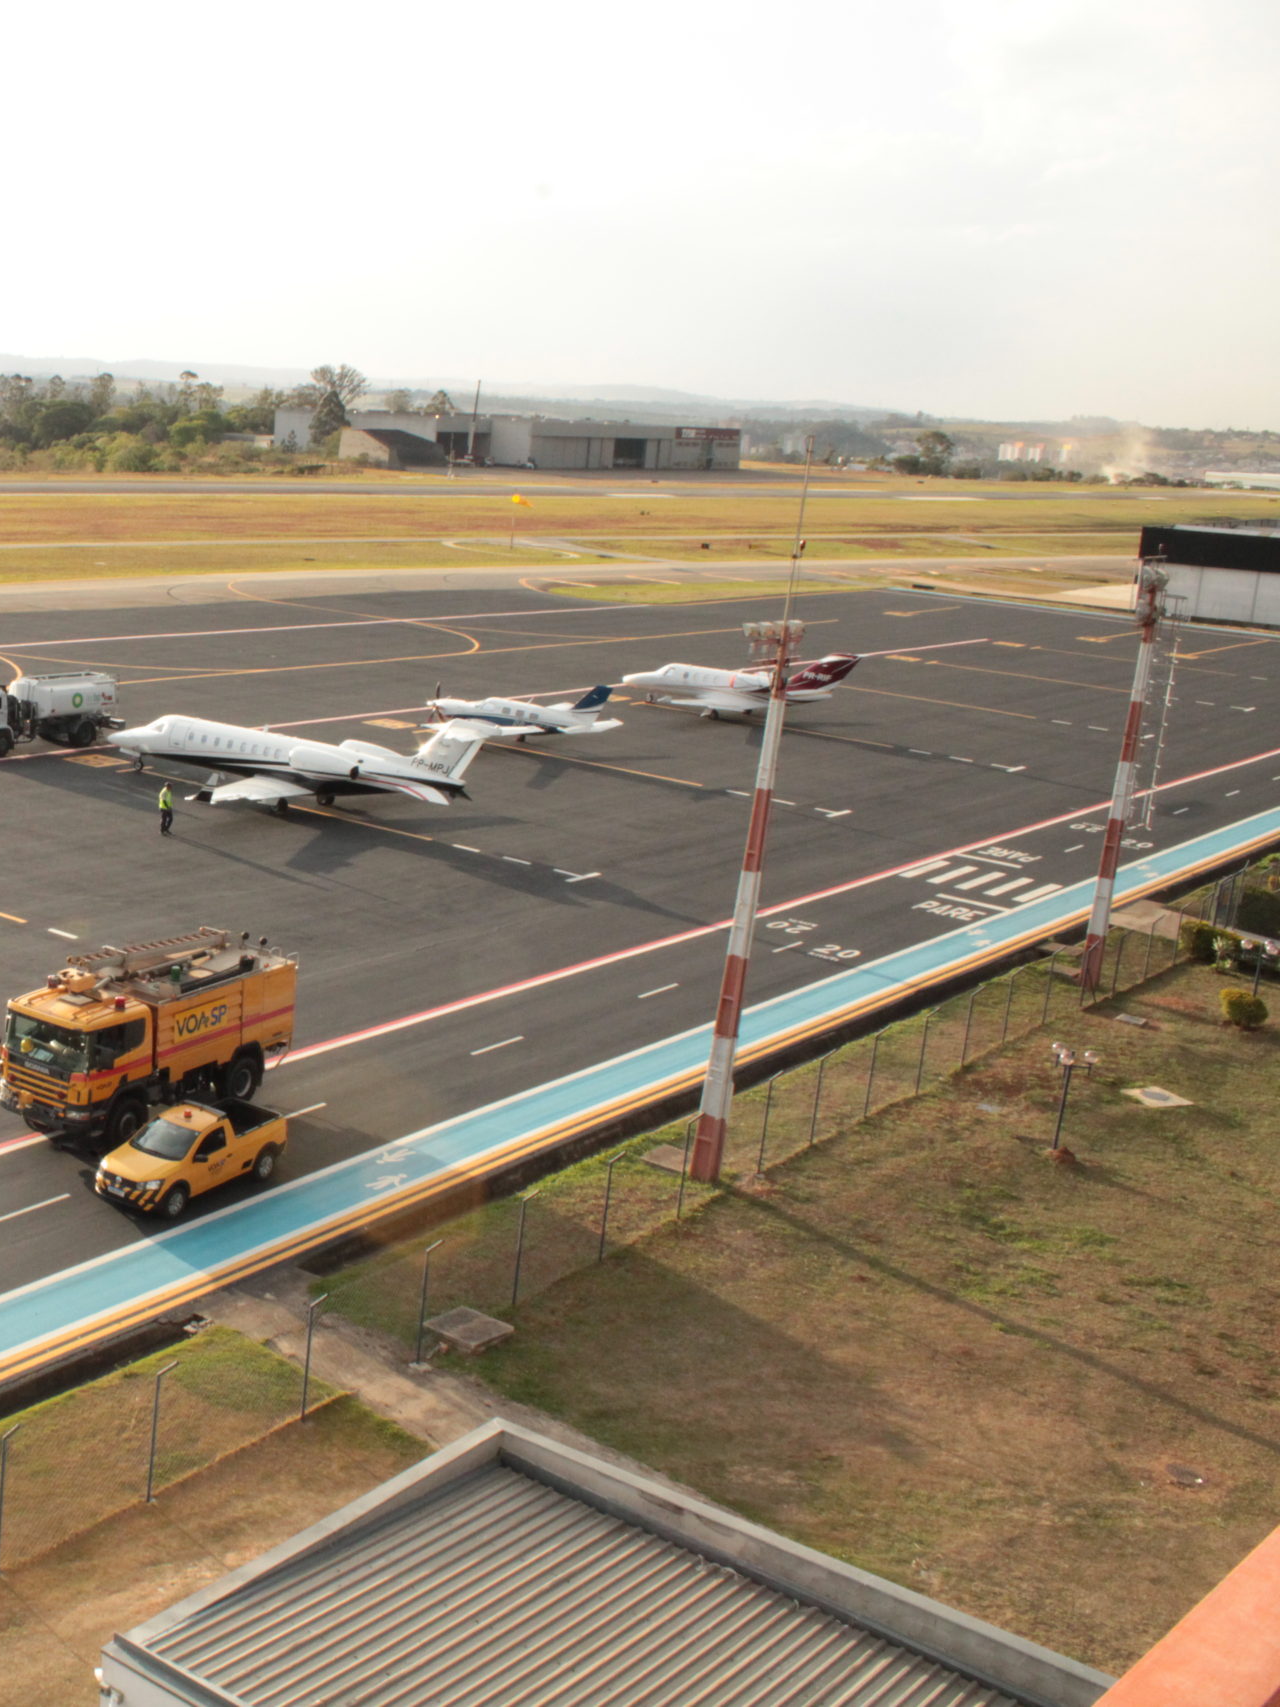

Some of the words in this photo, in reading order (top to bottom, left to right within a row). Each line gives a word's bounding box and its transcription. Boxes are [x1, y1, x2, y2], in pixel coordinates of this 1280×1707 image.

[977, 846, 1043, 863] PARE
[911, 900, 988, 921] PARE
[765, 921, 813, 934] 20
[812, 944, 862, 959] 20
